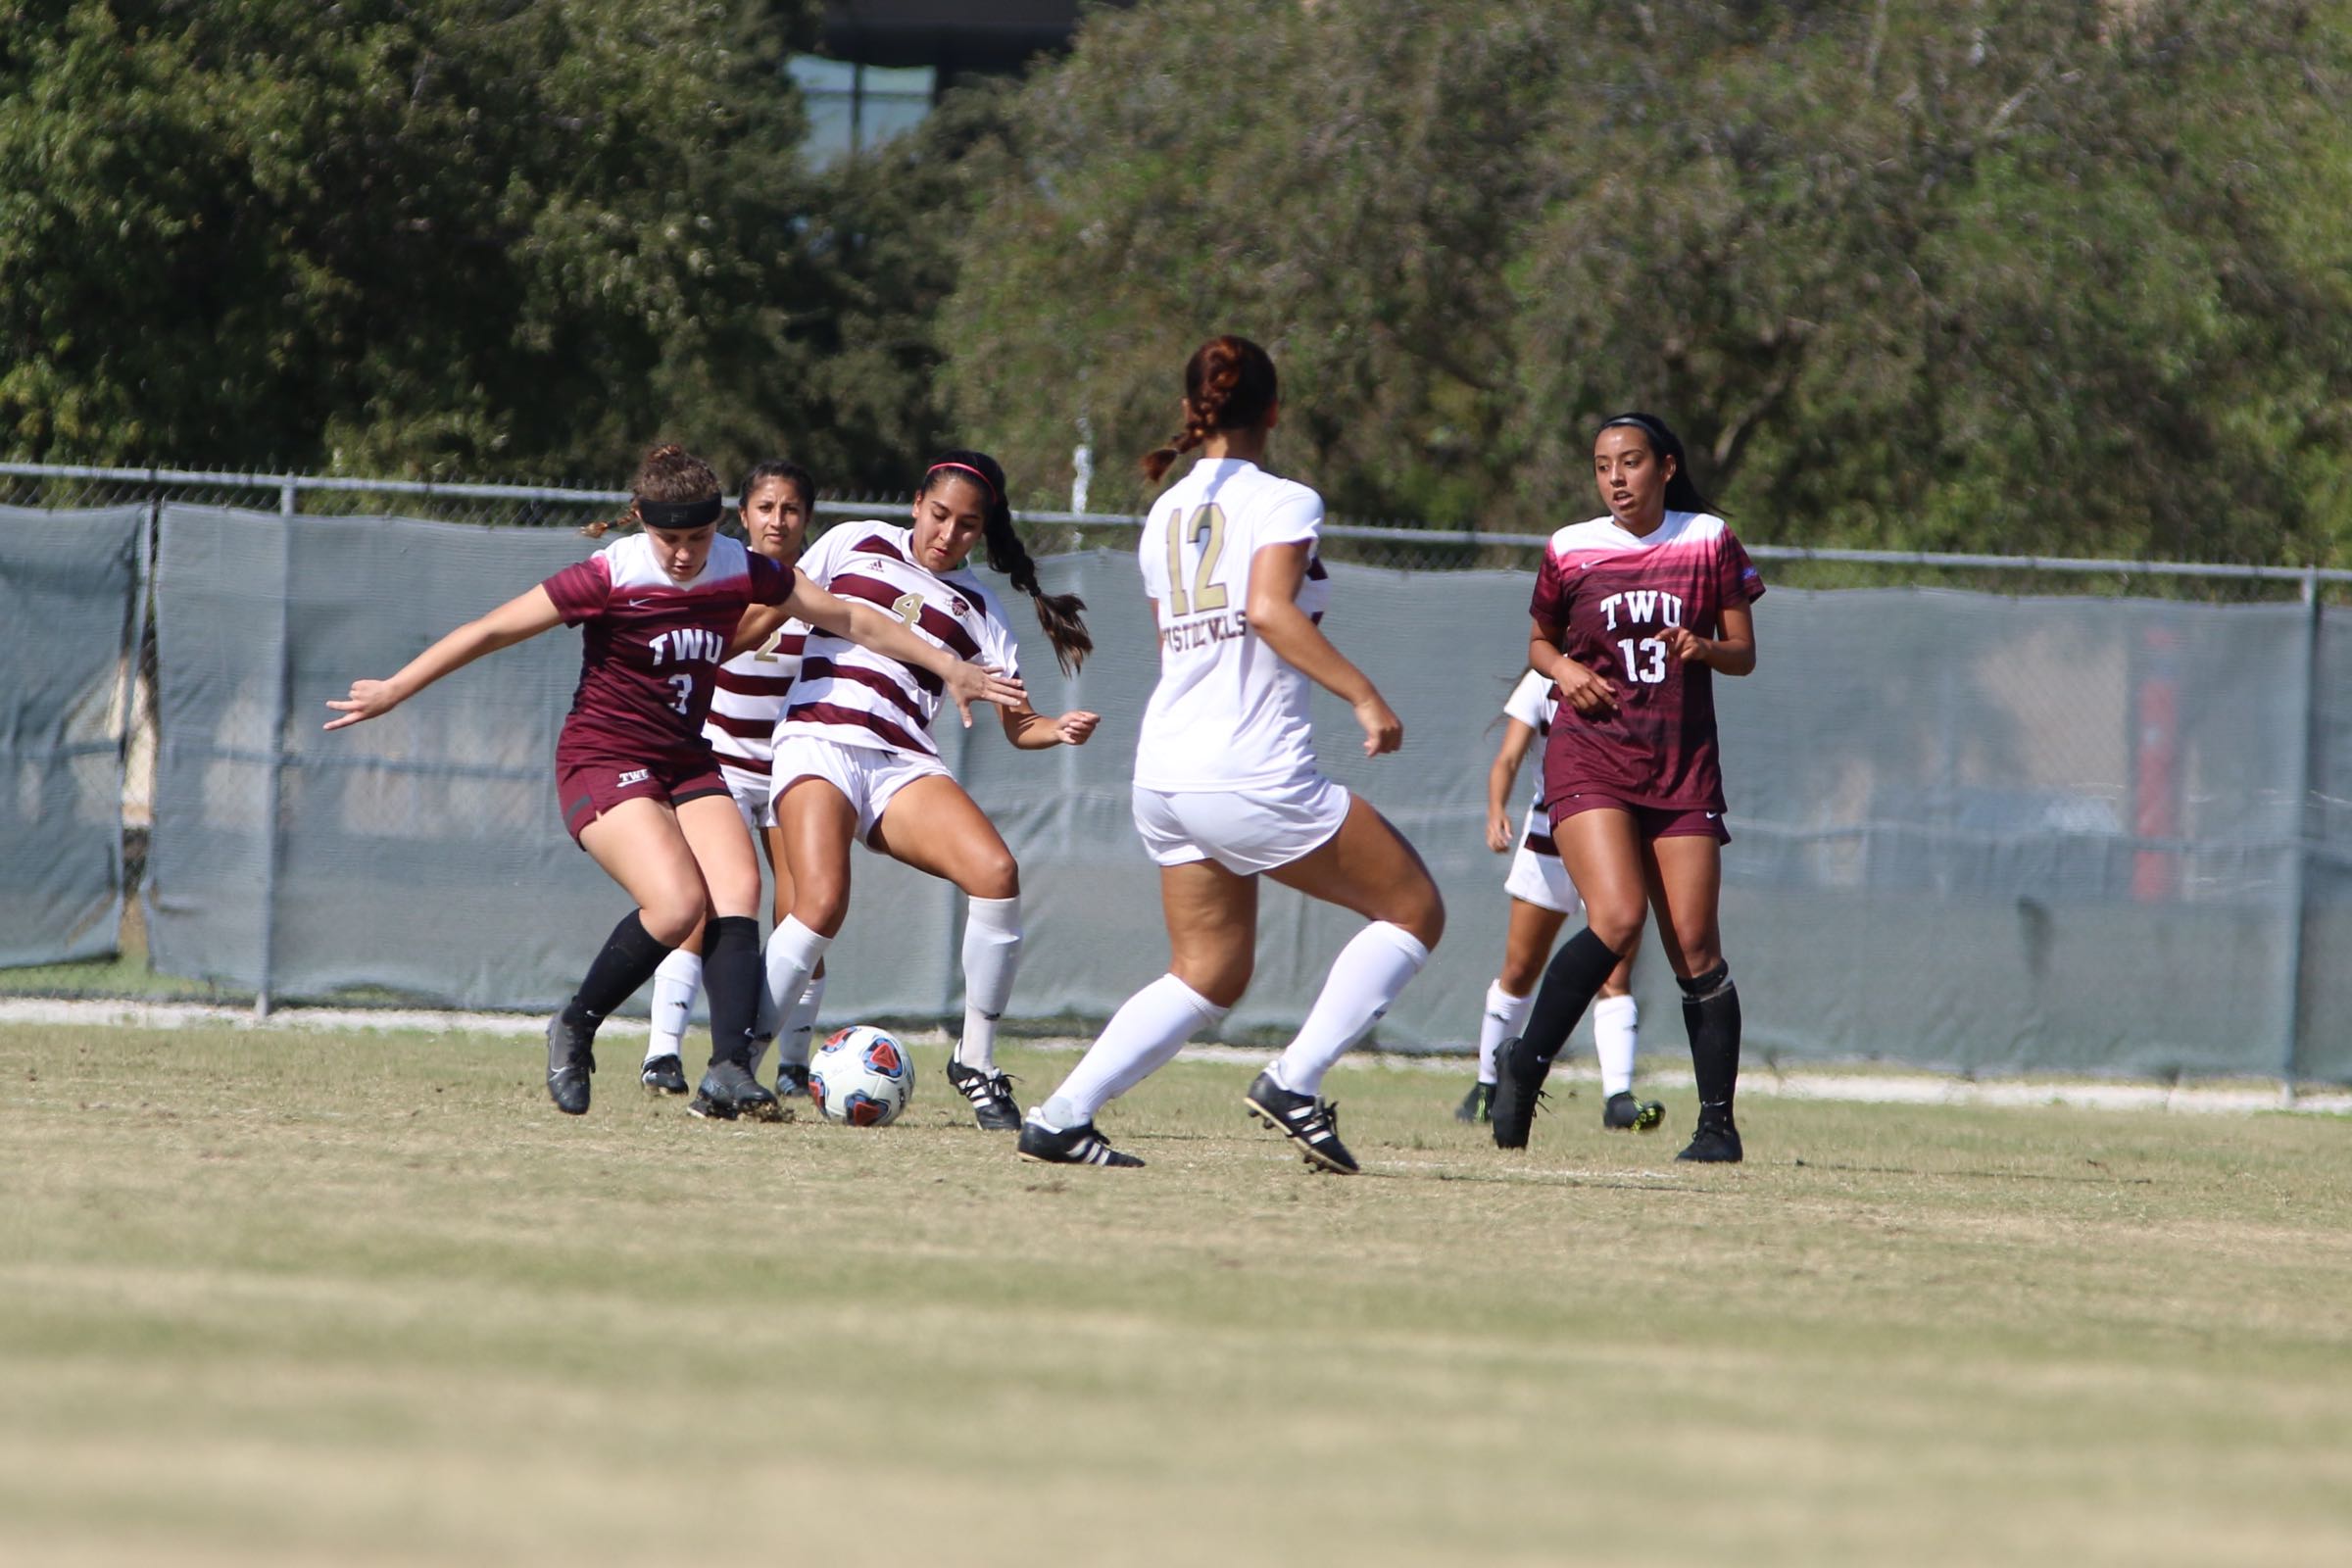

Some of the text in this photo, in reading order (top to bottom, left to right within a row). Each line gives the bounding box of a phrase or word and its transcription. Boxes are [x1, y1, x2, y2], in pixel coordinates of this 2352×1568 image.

[1166, 502, 1228, 617] 12
[892, 592, 924, 628] 4
[1600, 590, 1682, 631] TWU
[649, 628, 723, 666] TWU
[1617, 637, 1666, 683] 13
[667, 673, 692, 714] 3
